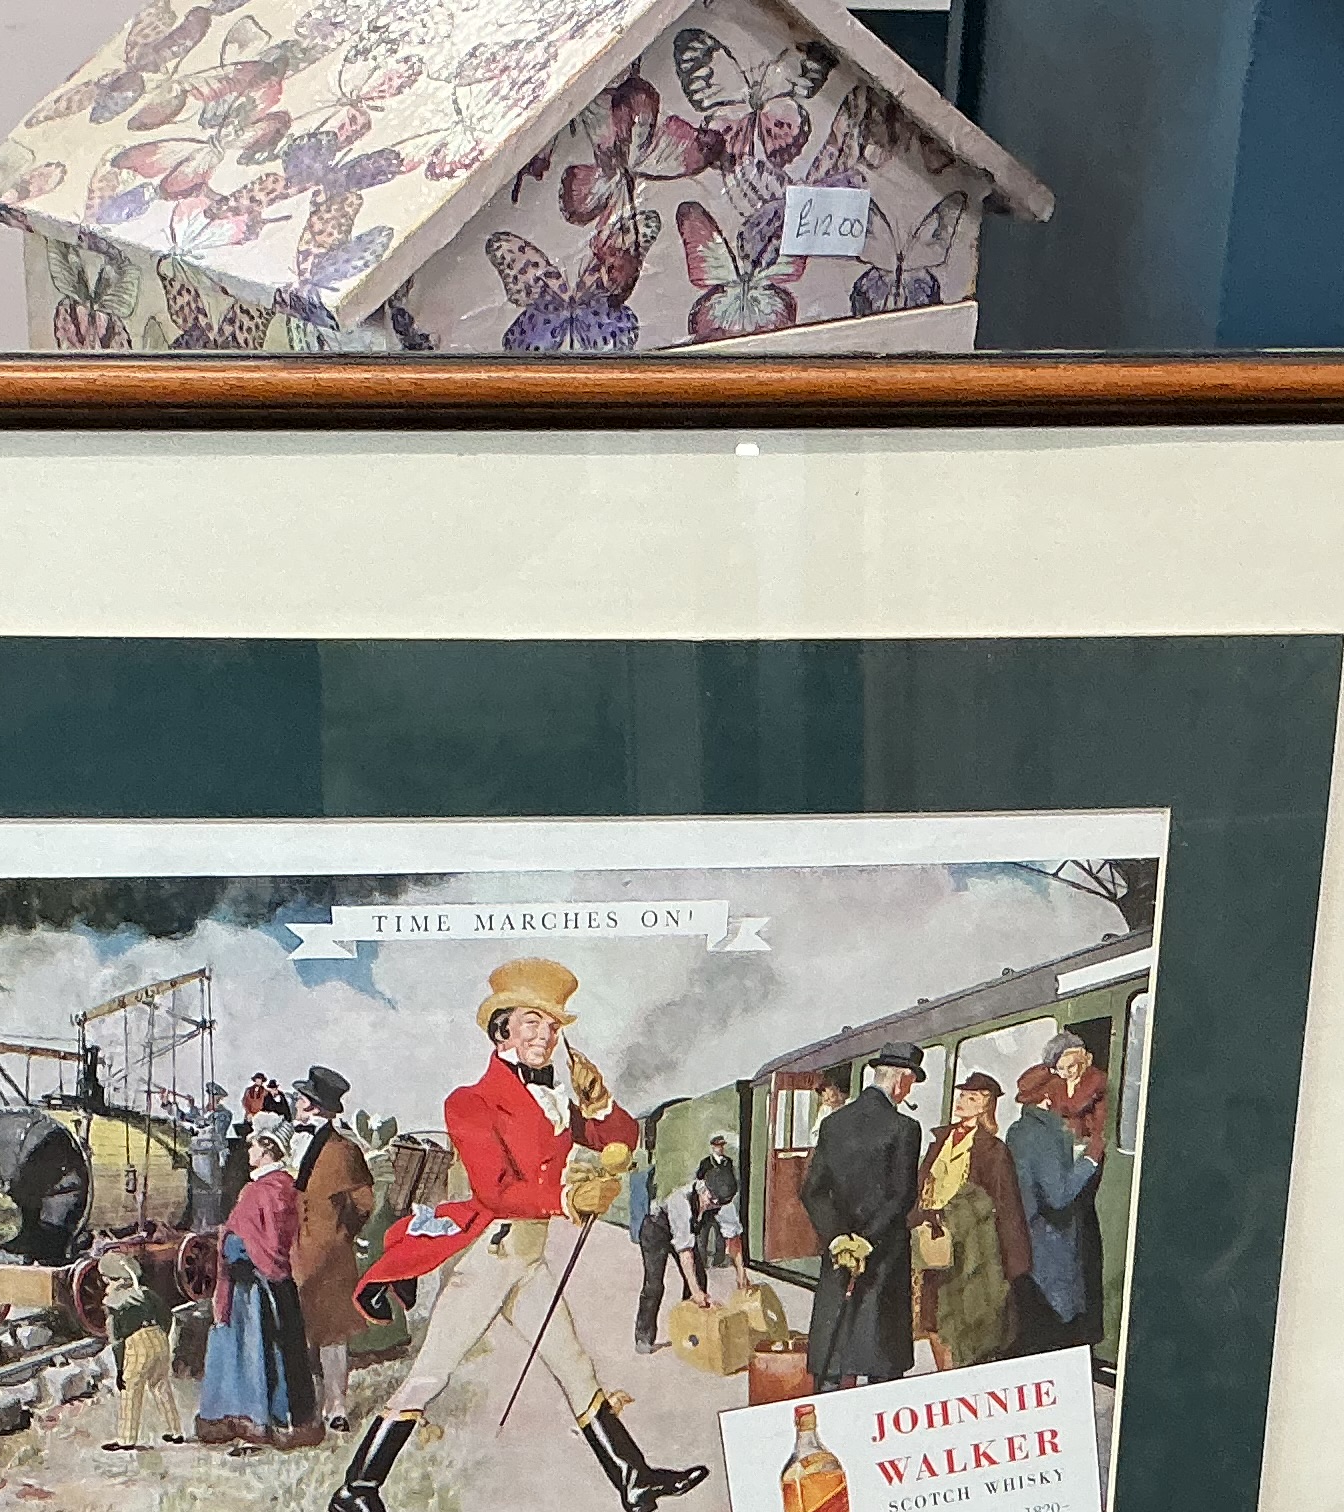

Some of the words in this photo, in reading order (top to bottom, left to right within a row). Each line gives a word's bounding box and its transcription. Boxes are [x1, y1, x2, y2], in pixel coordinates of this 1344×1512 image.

[371, 913, 452, 933] TIME
[473, 910, 620, 933] MARCHES
[870, 1378, 1058, 1444] JOHNNIE
[874, 1427, 1063, 1487] WALKER
[983, 1468, 1067, 1496] WHISKY
